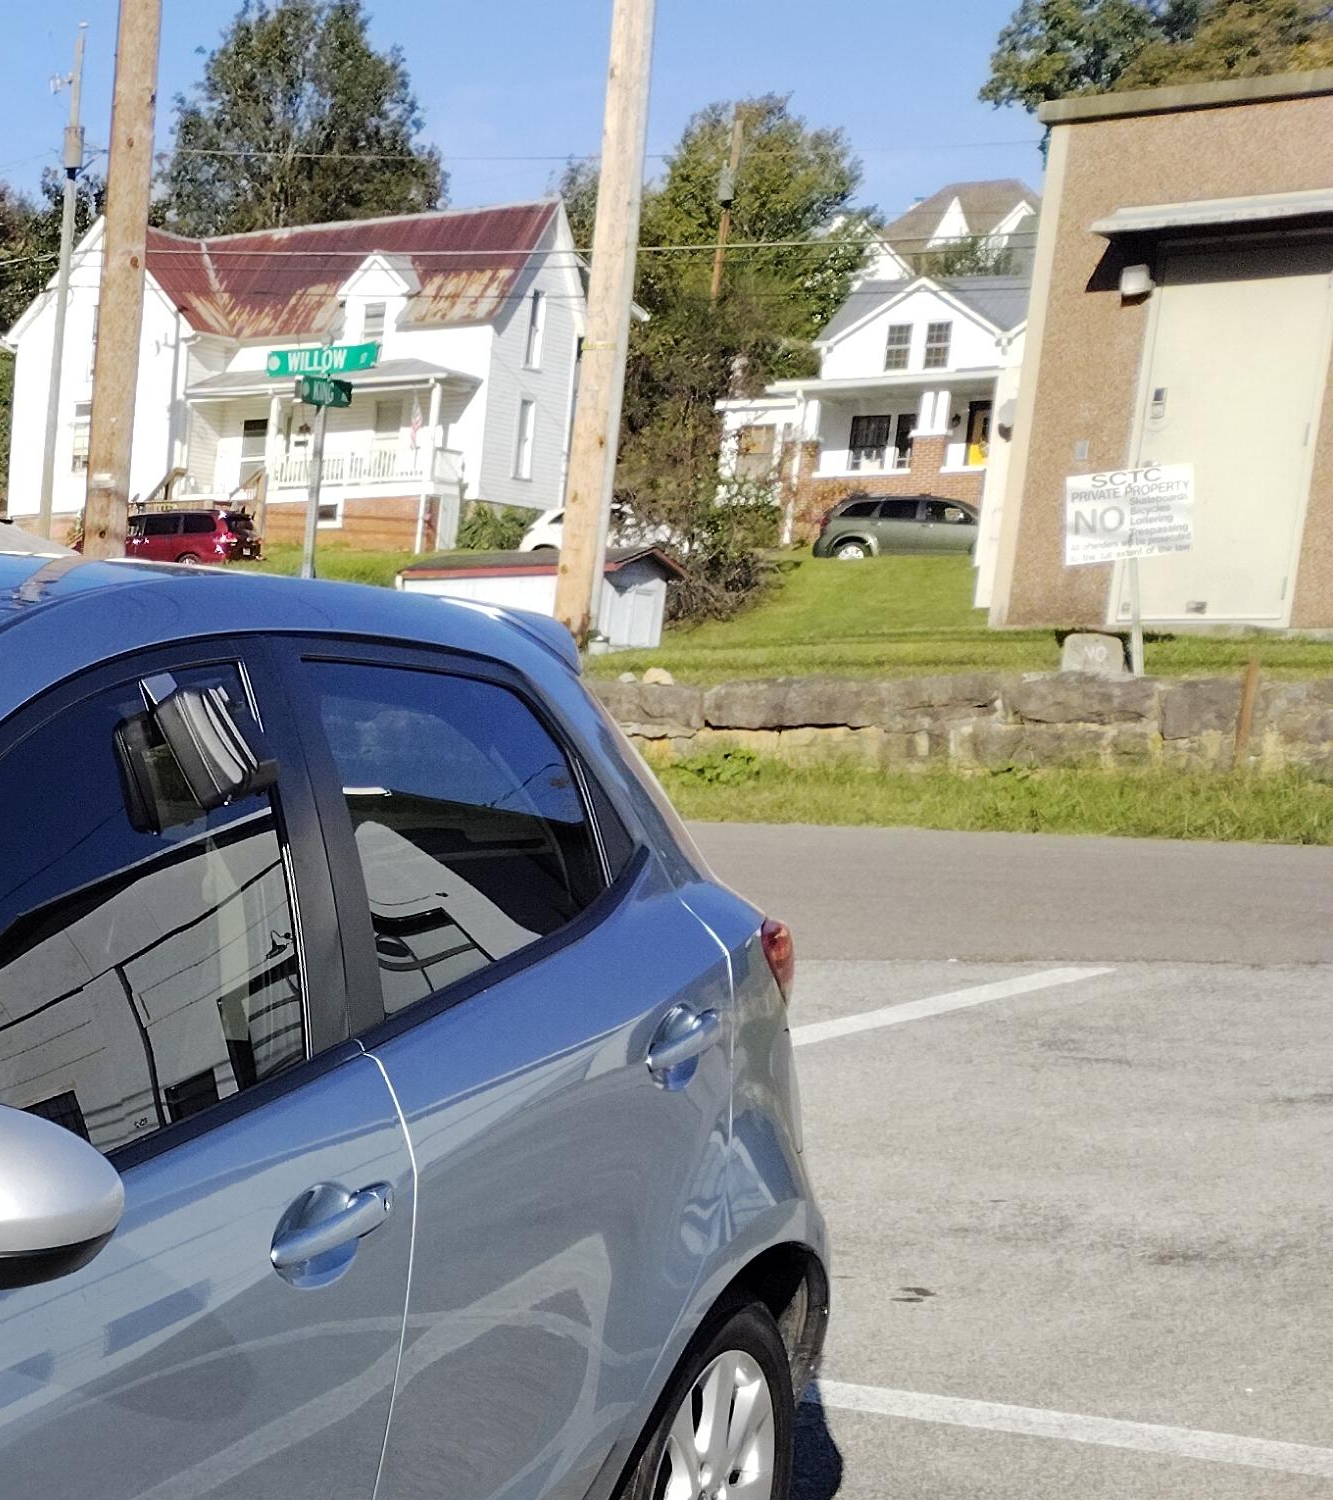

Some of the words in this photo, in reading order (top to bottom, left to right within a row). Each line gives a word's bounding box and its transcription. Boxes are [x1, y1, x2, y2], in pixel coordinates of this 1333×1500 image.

[288, 349, 347, 372] WILLOW
[313, 381, 334, 405] KING
[1091, 467, 1162, 489] SCTC
[1071, 487, 1121, 503] PRIVATE
[1124, 480, 1190, 498] PROPERTY
[1129, 493, 1188, 506] Skateboards
[1130, 504, 1172, 516] Bicycles
[1074, 505, 1125, 535] NO
[1130, 514, 1174, 526] Loitering
[1129, 523, 1189, 537] Trespassing
[1117, 547, 1143, 557] extent
